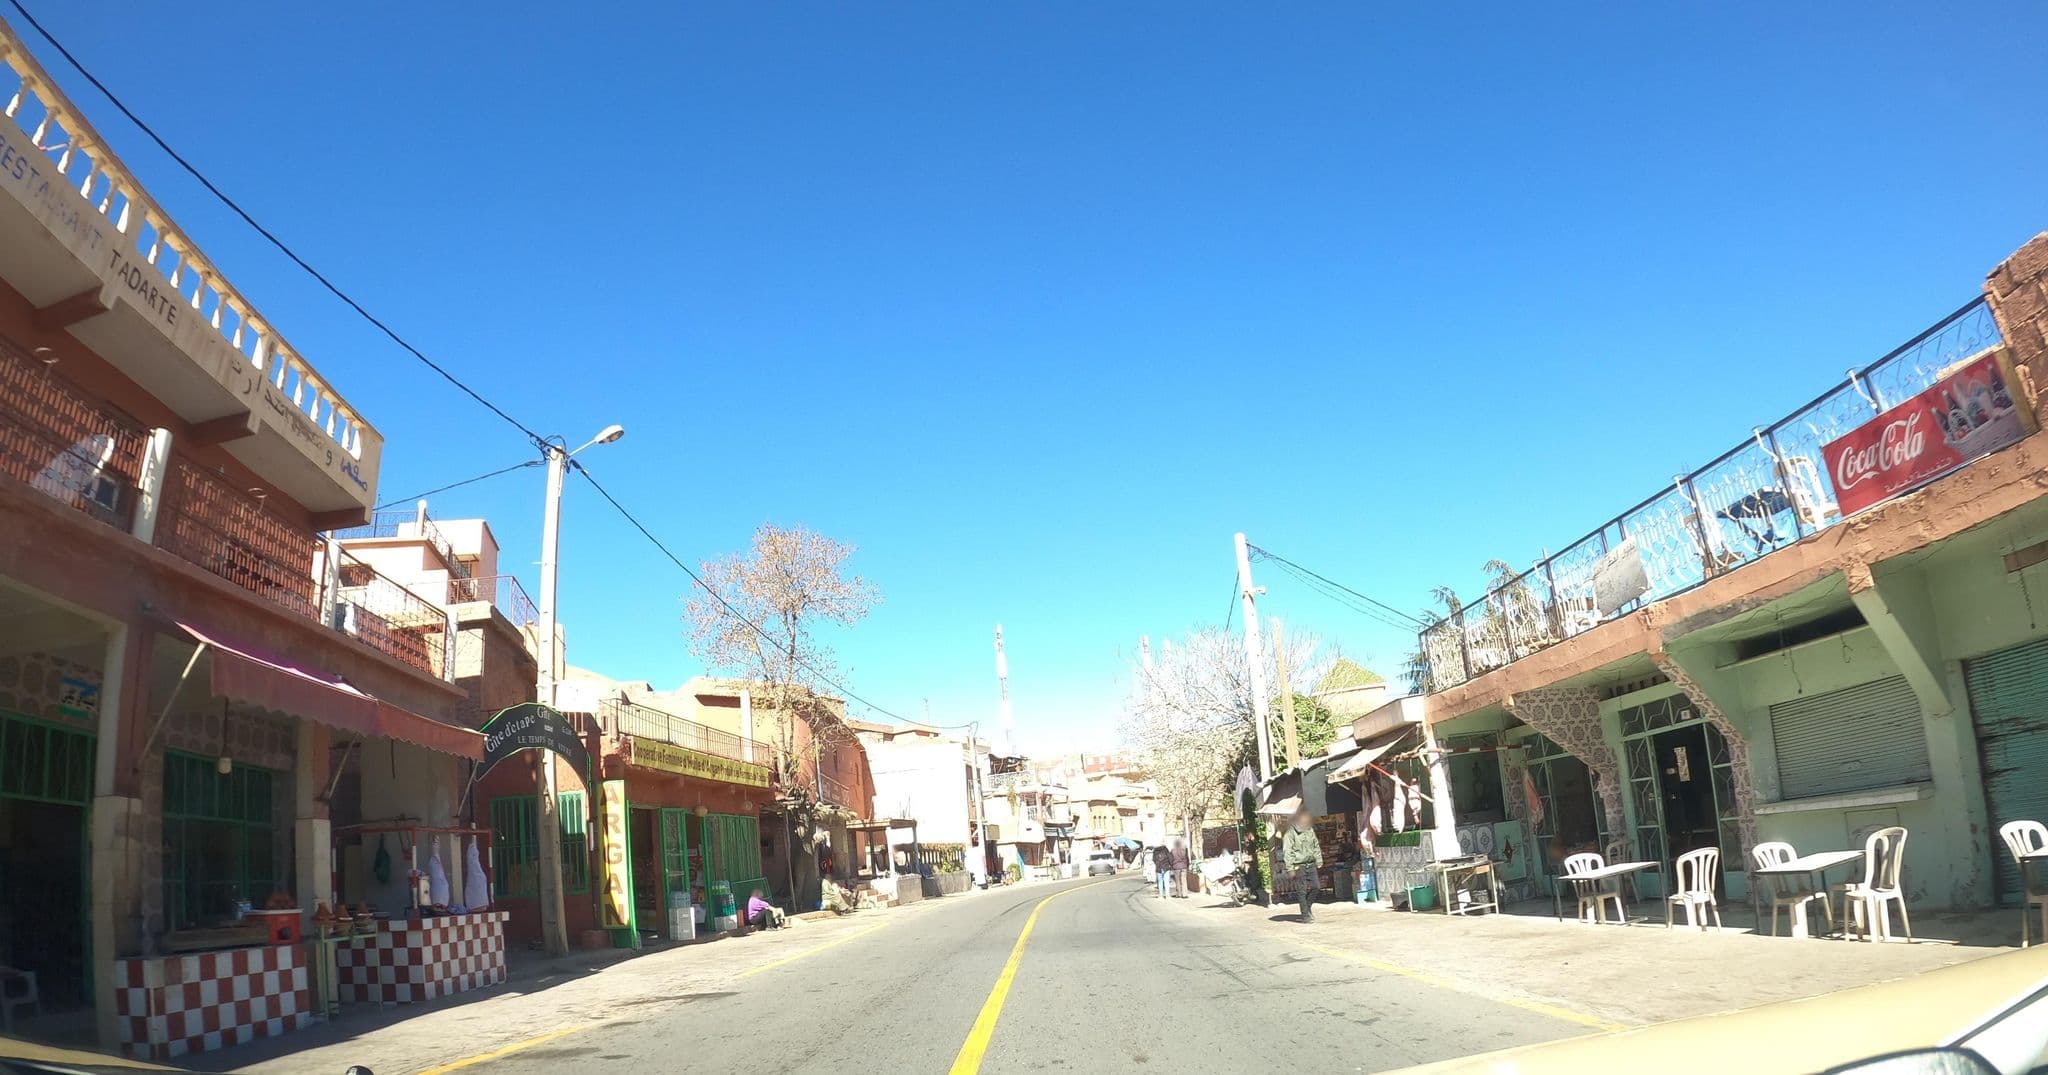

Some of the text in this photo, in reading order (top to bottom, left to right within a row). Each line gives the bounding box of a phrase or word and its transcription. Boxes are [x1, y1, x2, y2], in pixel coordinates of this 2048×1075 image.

[110, 248, 177, 327] TADARTE
[1837, 408, 1925, 490] Coca-Cola
[517, 735, 527, 744] LE
[600, 784, 625, 926] ARGAN
